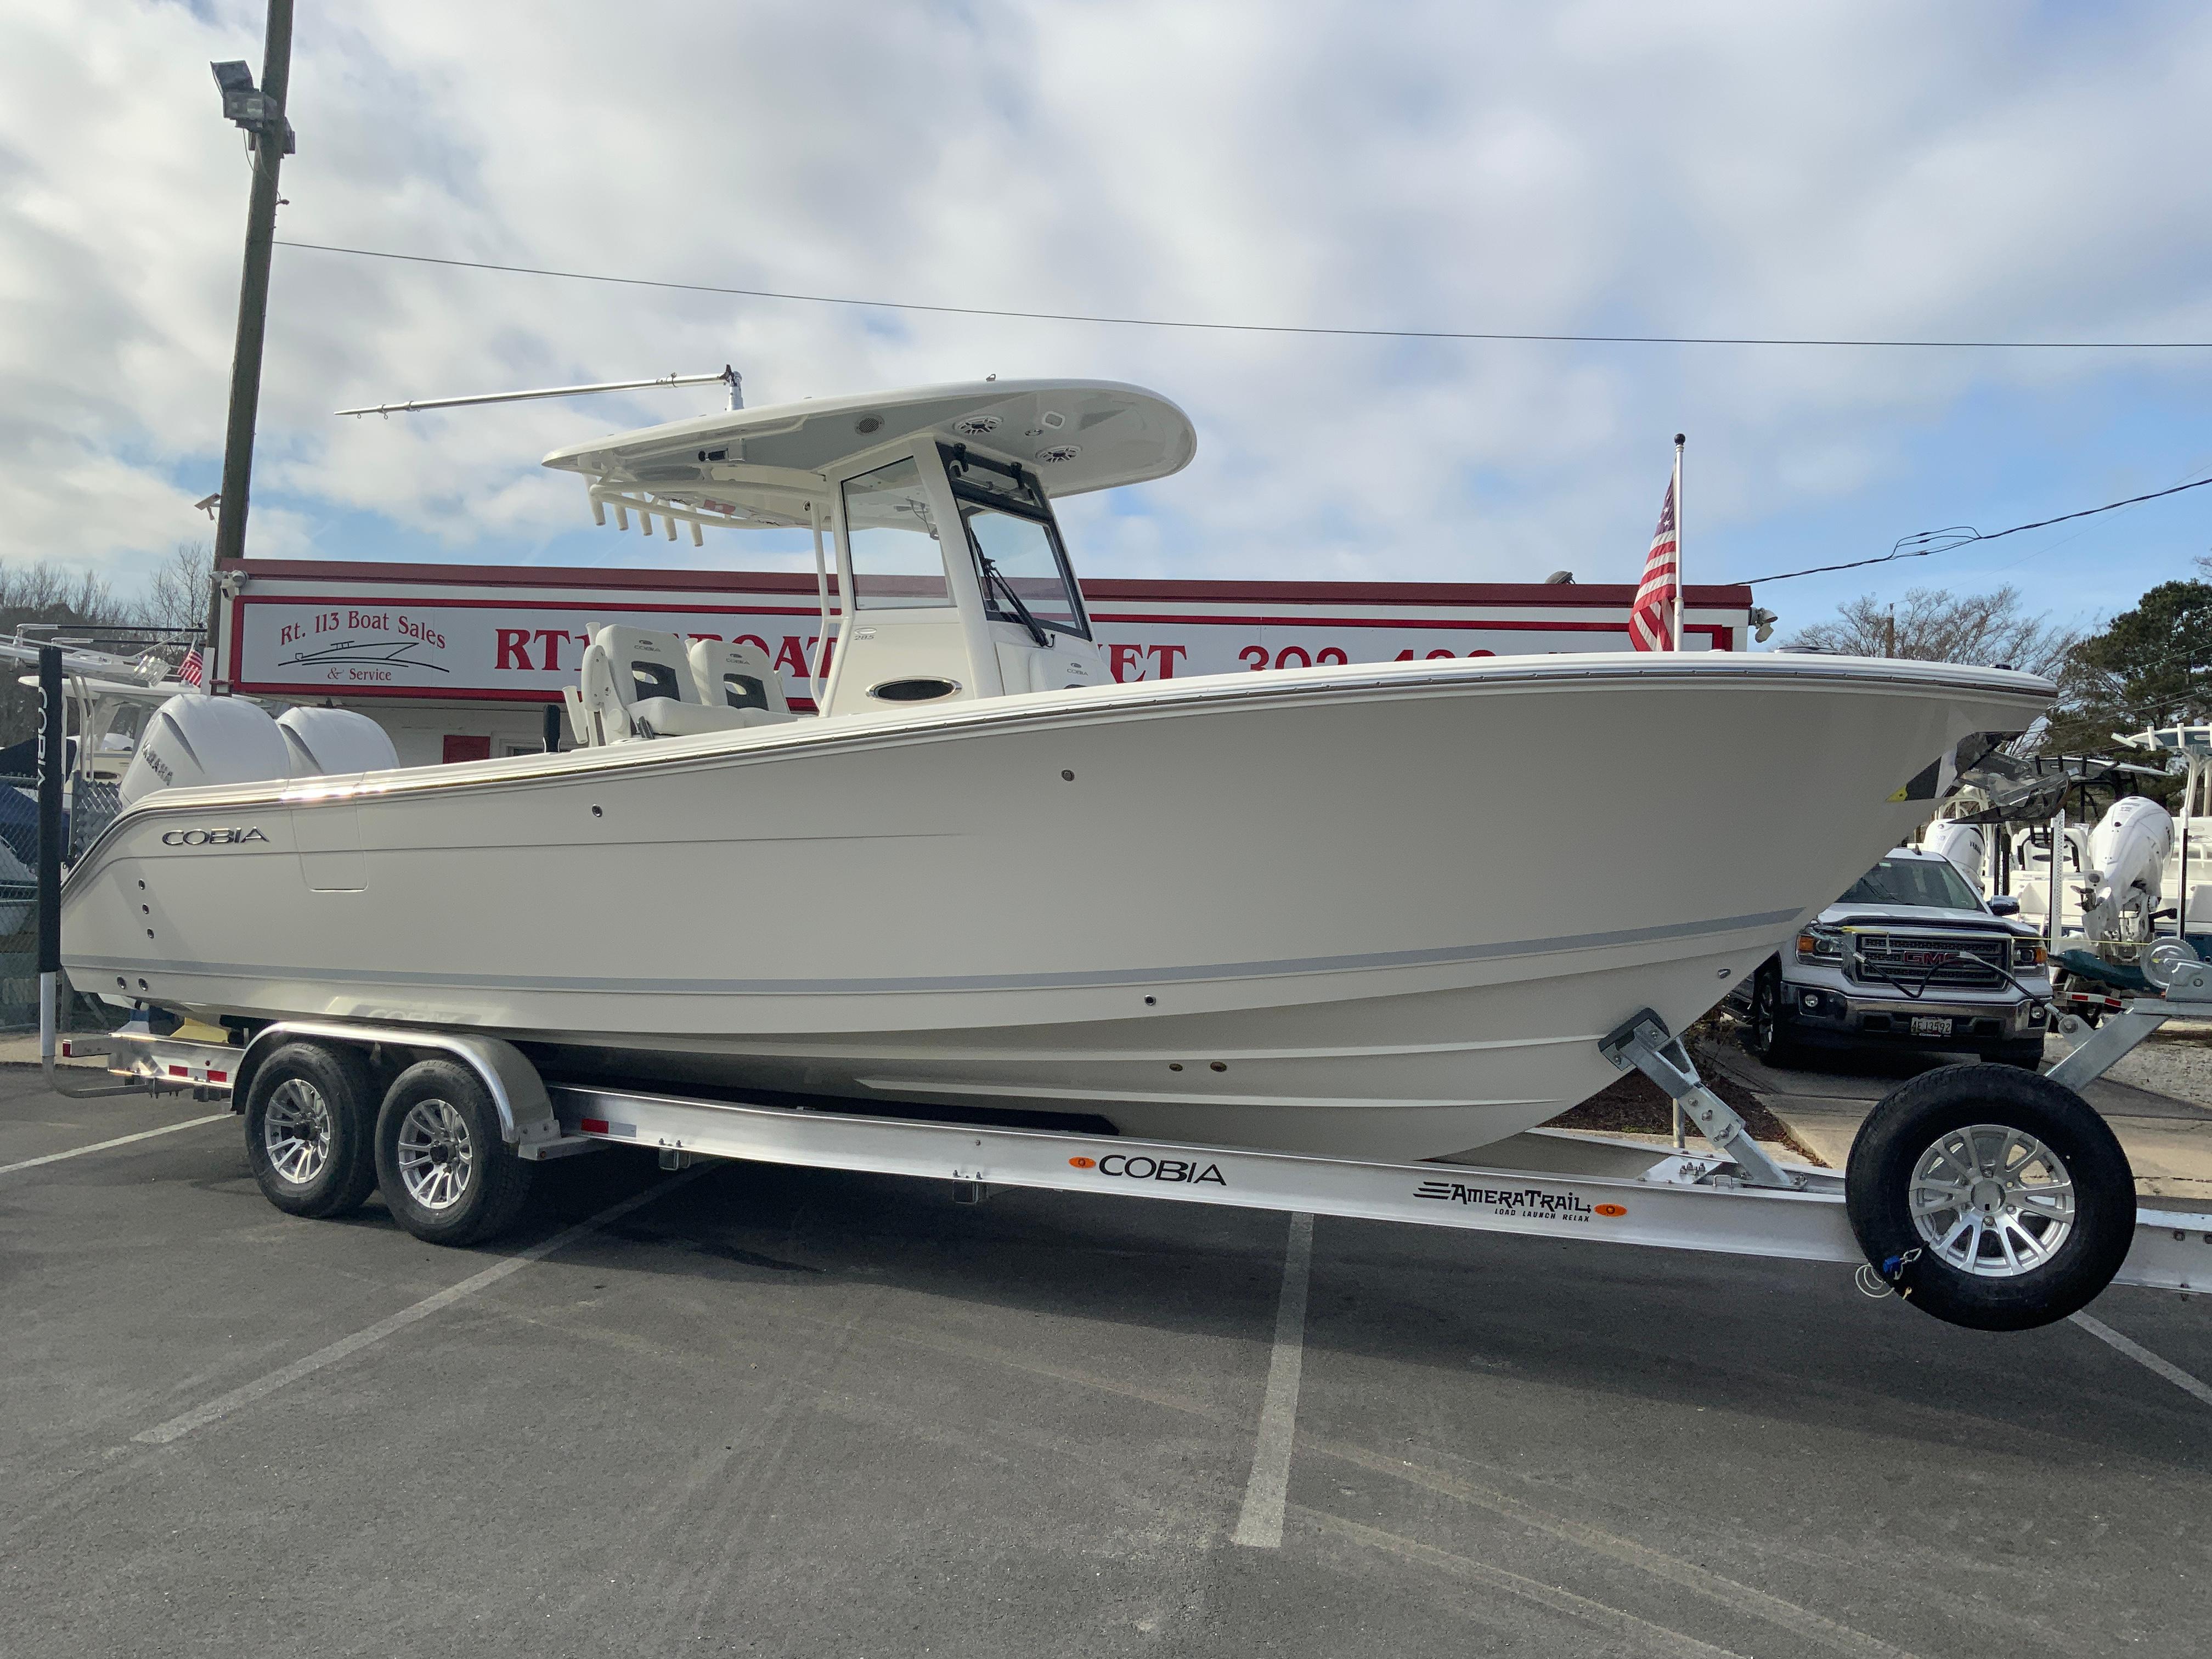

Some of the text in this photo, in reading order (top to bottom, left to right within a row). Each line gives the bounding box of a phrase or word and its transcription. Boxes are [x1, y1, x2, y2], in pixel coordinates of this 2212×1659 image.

[280, 610, 445, 649] Rt. 113 Boat Sales
[327, 667, 392, 681] & Service
[1066, 668, 1089, 676] COBIA
[162, 826, 270, 846] COBIA
[1099, 1154, 1227, 1186] COBIA
[1522, 1210, 1556, 1220] LAUNCH
[1562, 1214, 1590, 1222] RELAX
